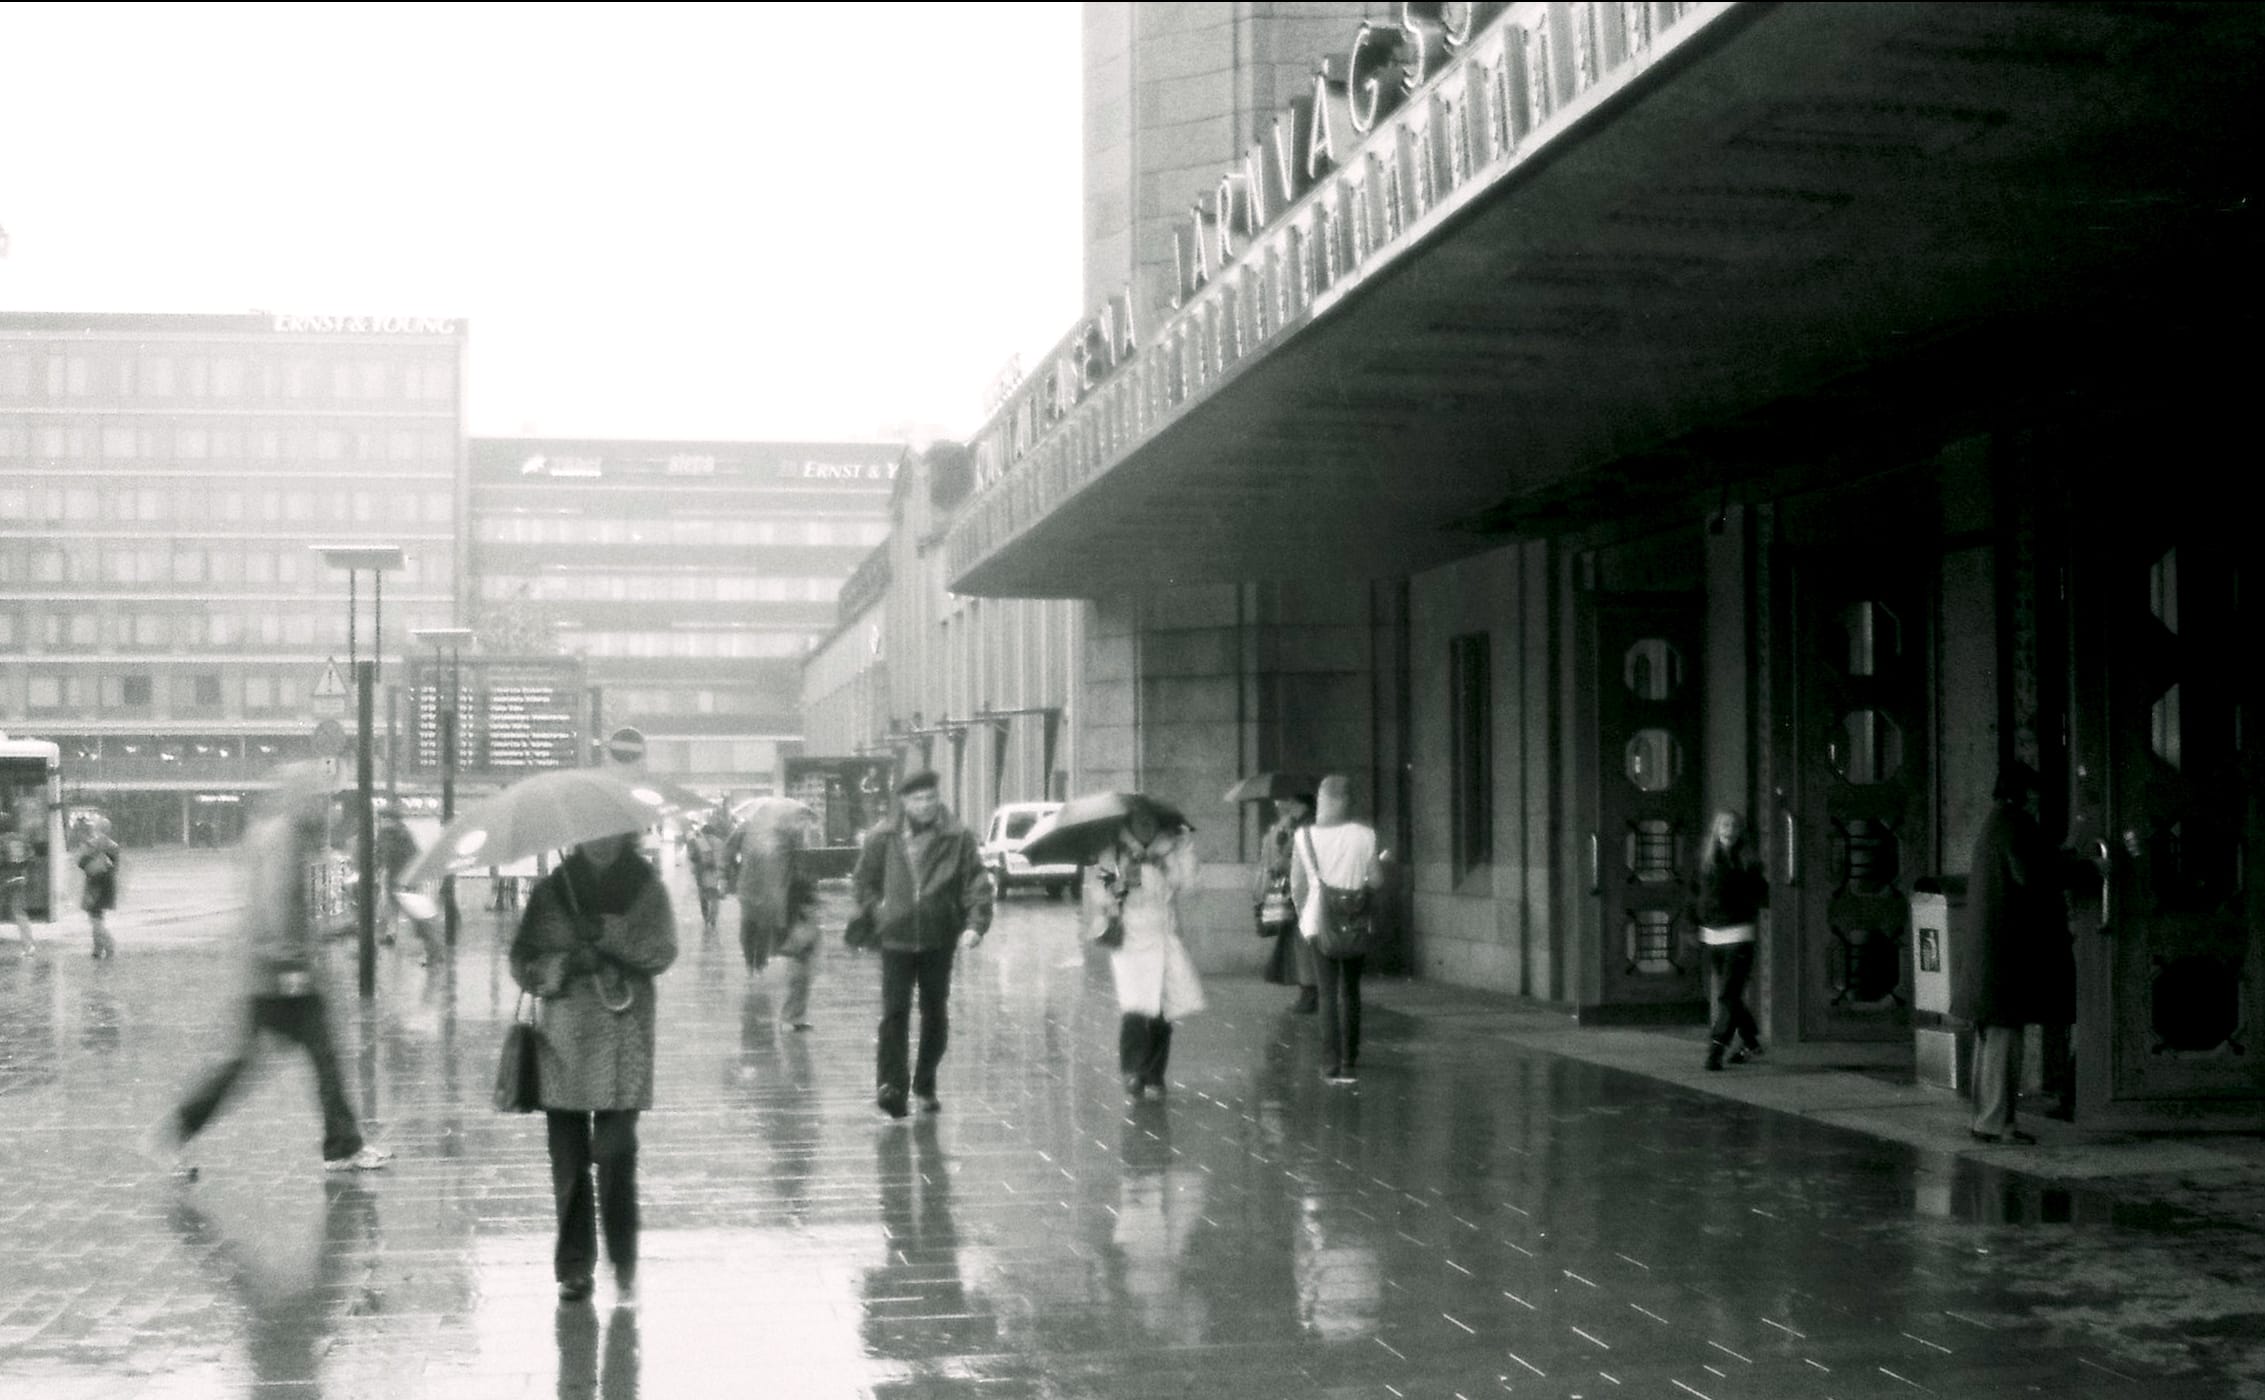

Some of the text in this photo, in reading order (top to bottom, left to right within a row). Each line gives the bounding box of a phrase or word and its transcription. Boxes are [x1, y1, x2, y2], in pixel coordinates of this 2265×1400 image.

[273, 315, 345, 333] ERNST
[367, 316, 455, 334] YOUNG
[803, 461, 862, 478] ERNST
[867, 464, 880, 479] &
